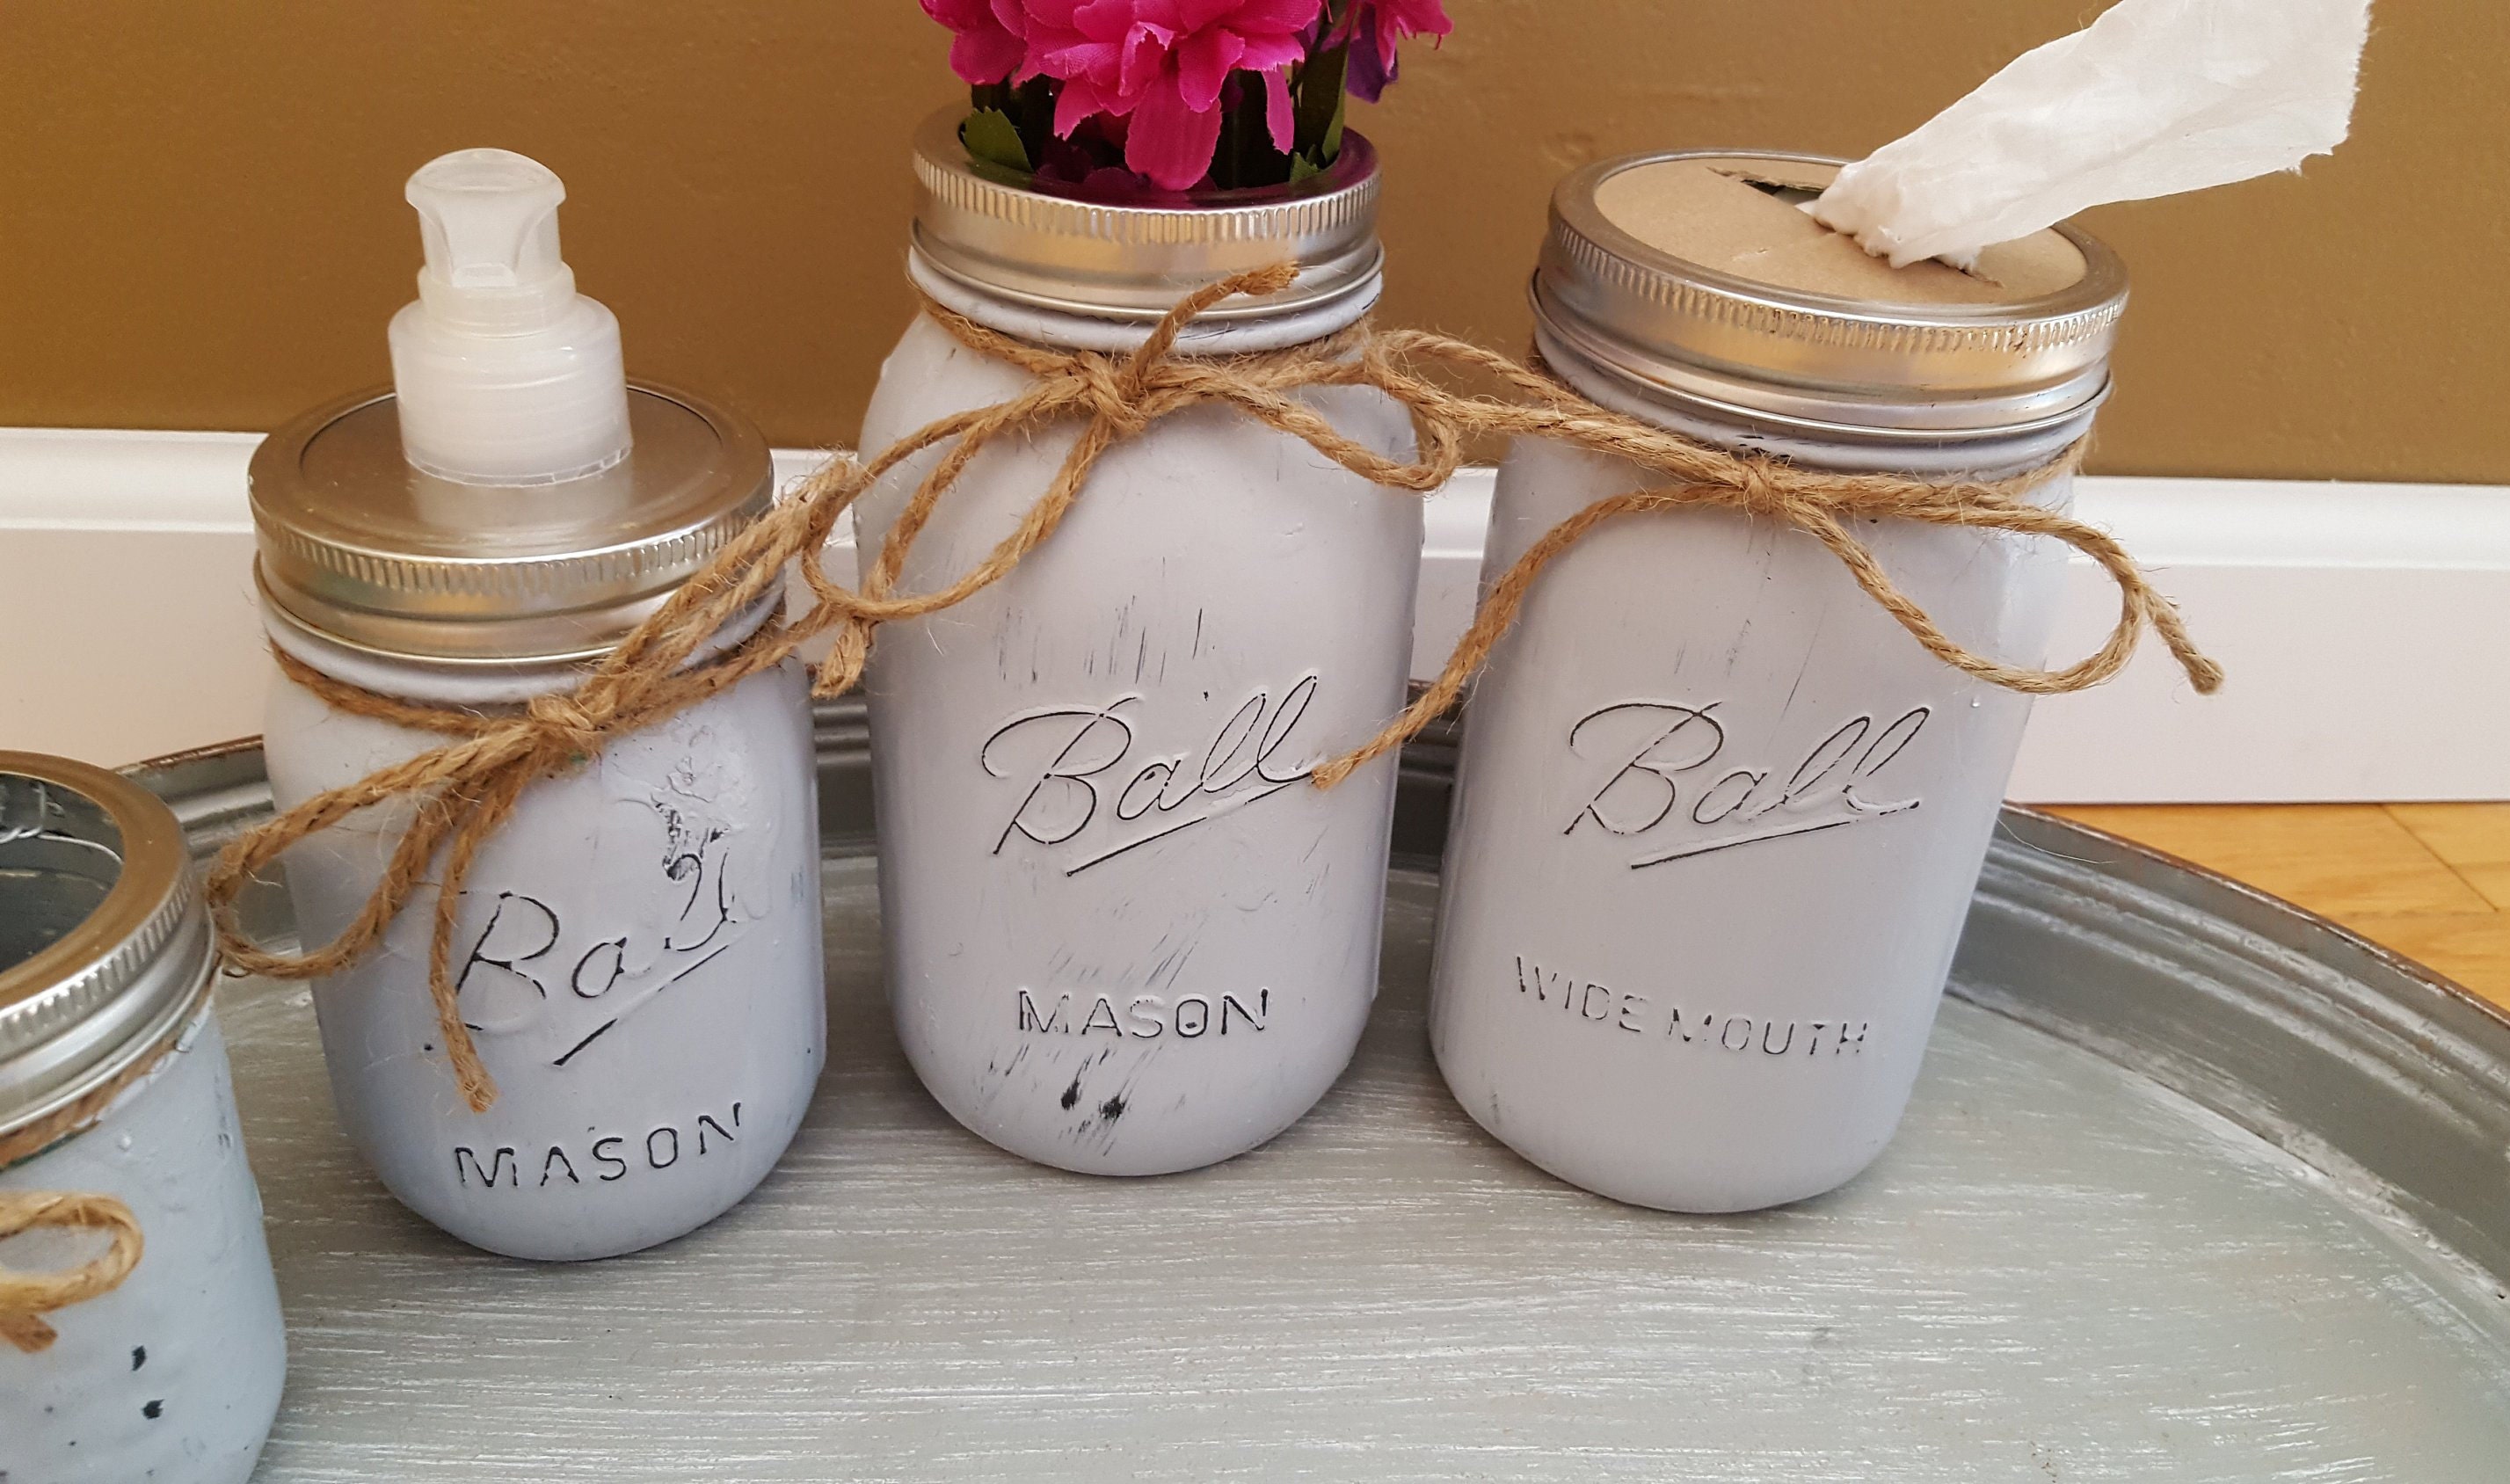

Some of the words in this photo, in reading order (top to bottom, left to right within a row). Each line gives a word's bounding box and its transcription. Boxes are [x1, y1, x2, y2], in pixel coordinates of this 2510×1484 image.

[981, 674, 1319, 874] Ball
[1564, 702, 1931, 869] Ball
[1017, 986, 1269, 1038] MASON
[1516, 955, 1648, 1033] WIDE
[1667, 1007, 1870, 1056] MOUTH
[454, 1102, 741, 1189] MASON
